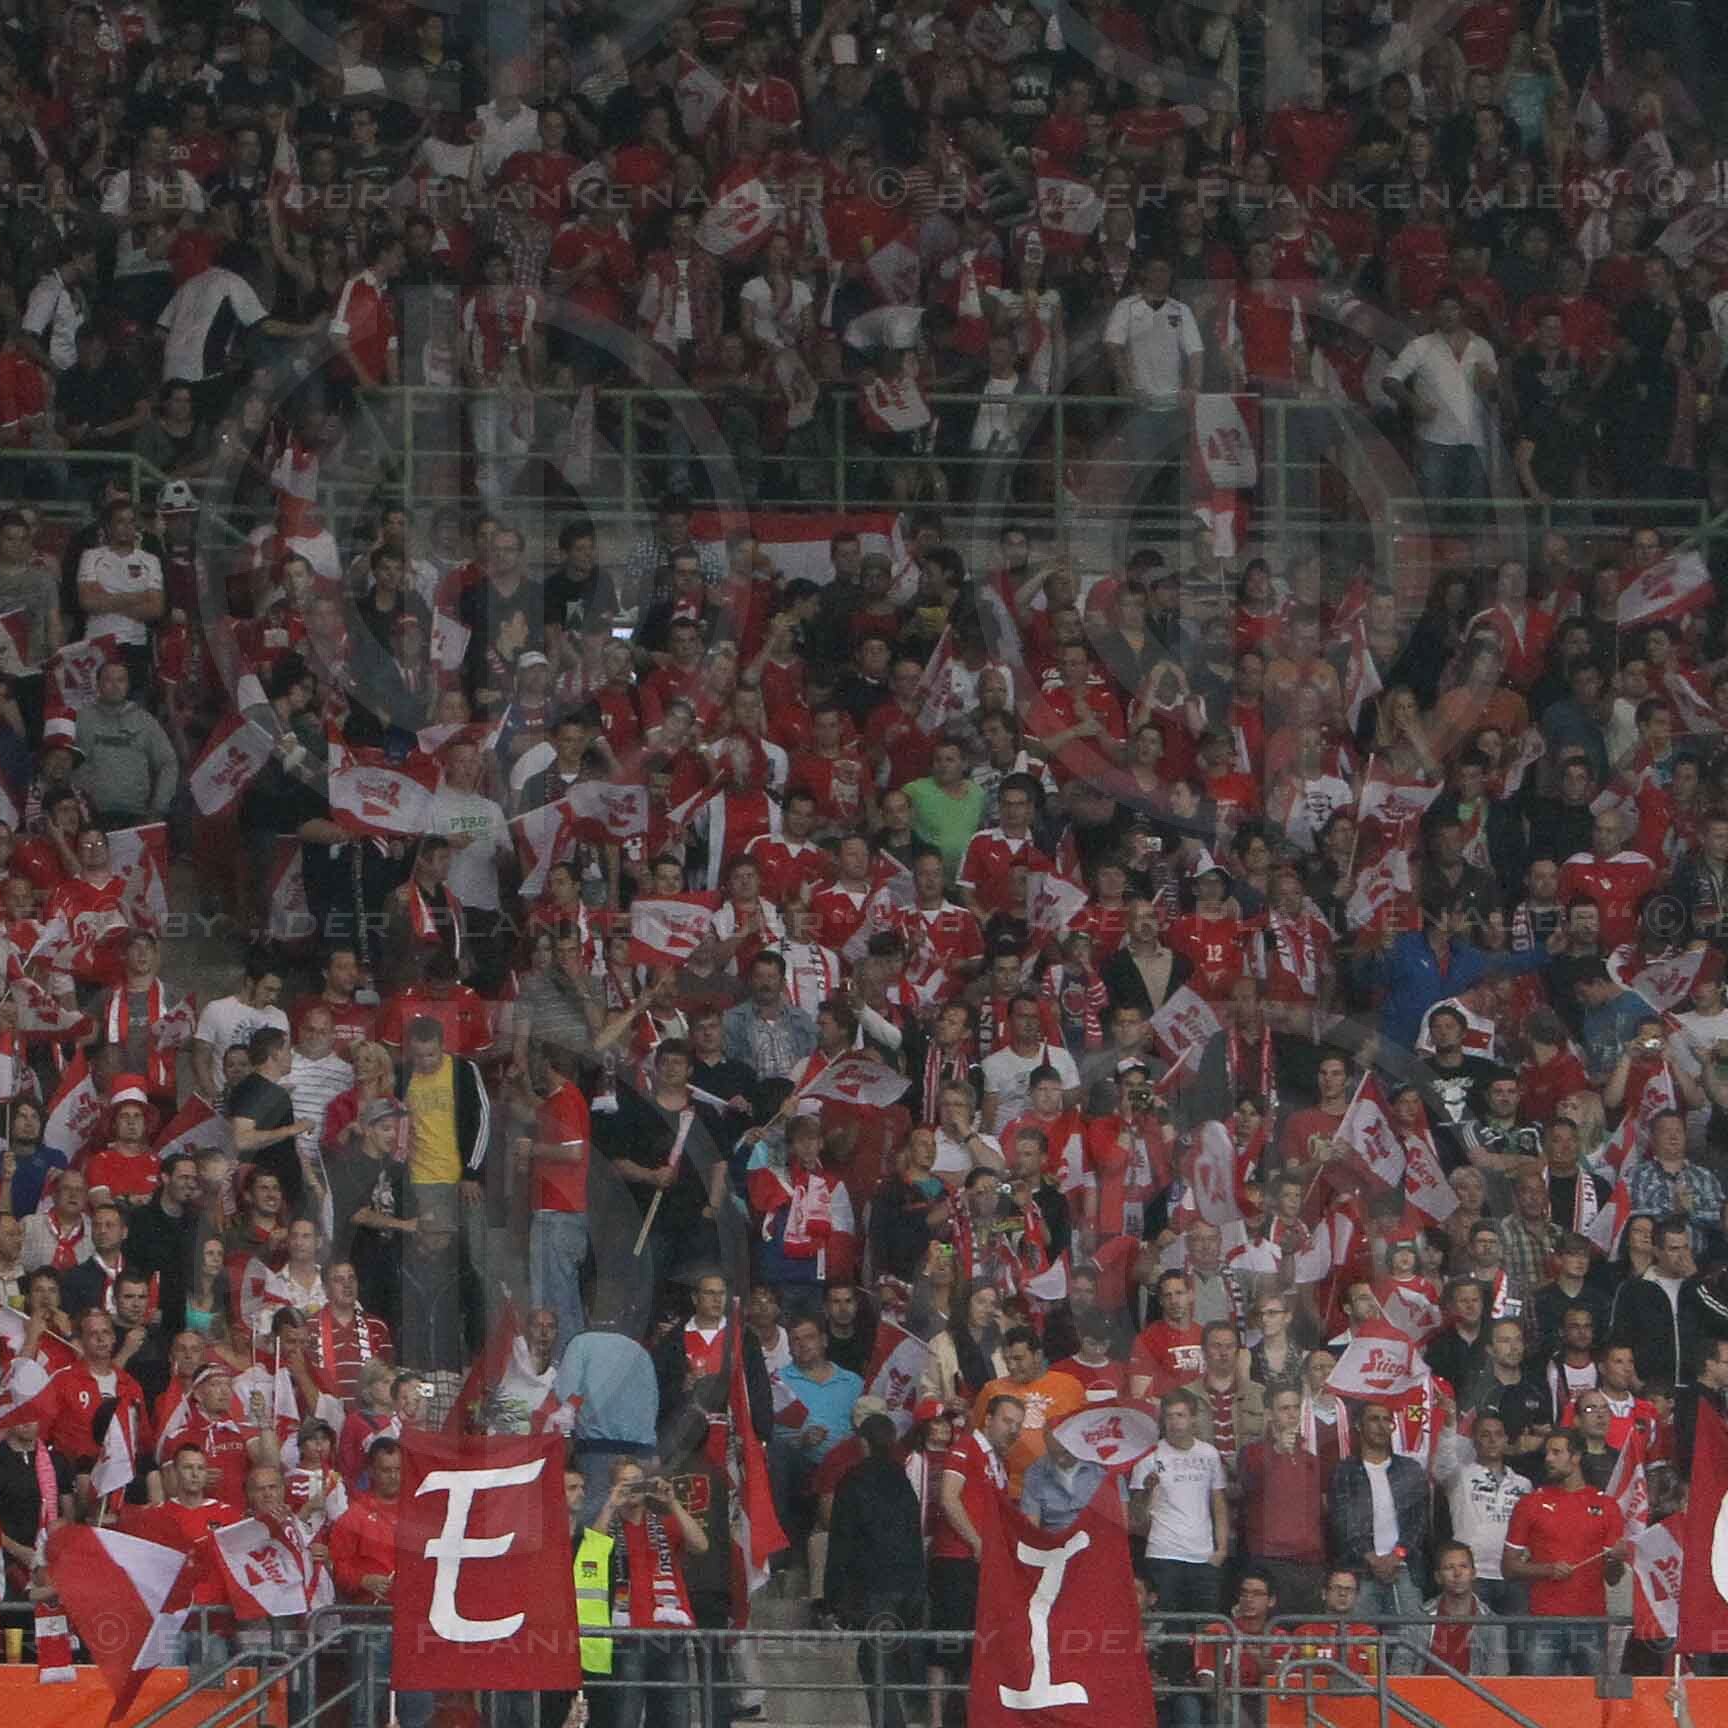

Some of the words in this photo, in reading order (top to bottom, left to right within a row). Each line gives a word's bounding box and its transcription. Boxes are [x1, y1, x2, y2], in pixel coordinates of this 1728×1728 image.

[78, 1391, 90, 1409] 9
[415, 1458, 545, 1641] E
[998, 1530, 1091, 1709] I
